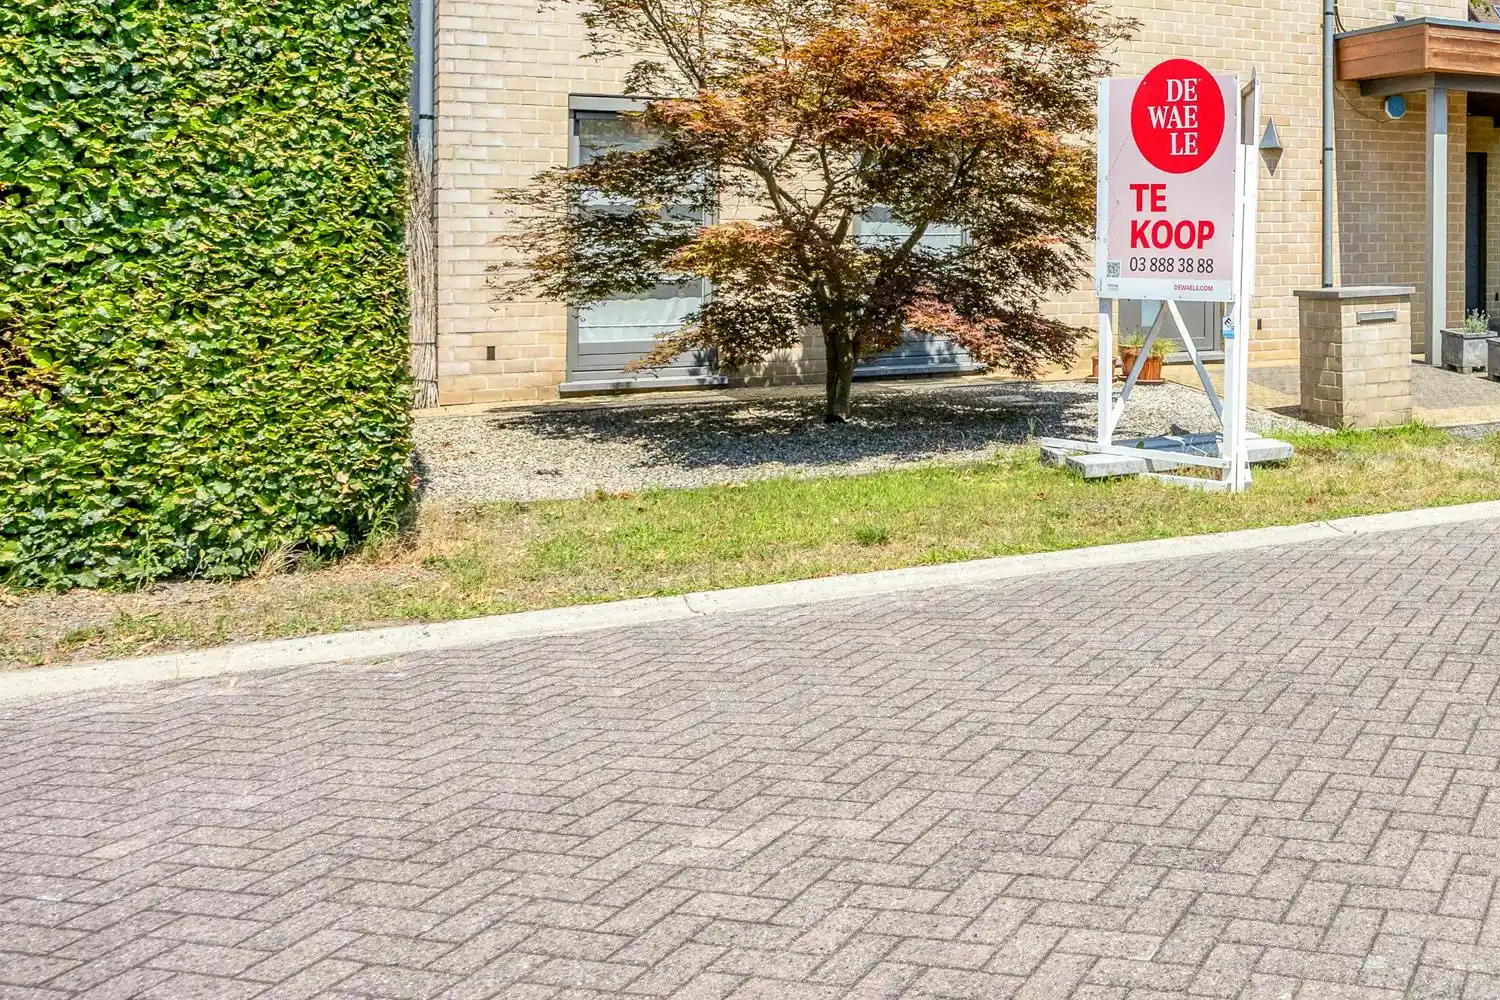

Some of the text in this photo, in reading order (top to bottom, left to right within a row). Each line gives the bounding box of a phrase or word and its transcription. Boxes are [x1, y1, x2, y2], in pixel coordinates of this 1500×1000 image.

[1166, 78, 1198, 102] DE
[1147, 105, 1198, 129] WAE
[1170, 132, 1198, 155] LE
[1129, 183, 1167, 212] TE
[1130, 219, 1215, 249] KOOP
[1130, 256, 1214, 273] 03 888 38 88
